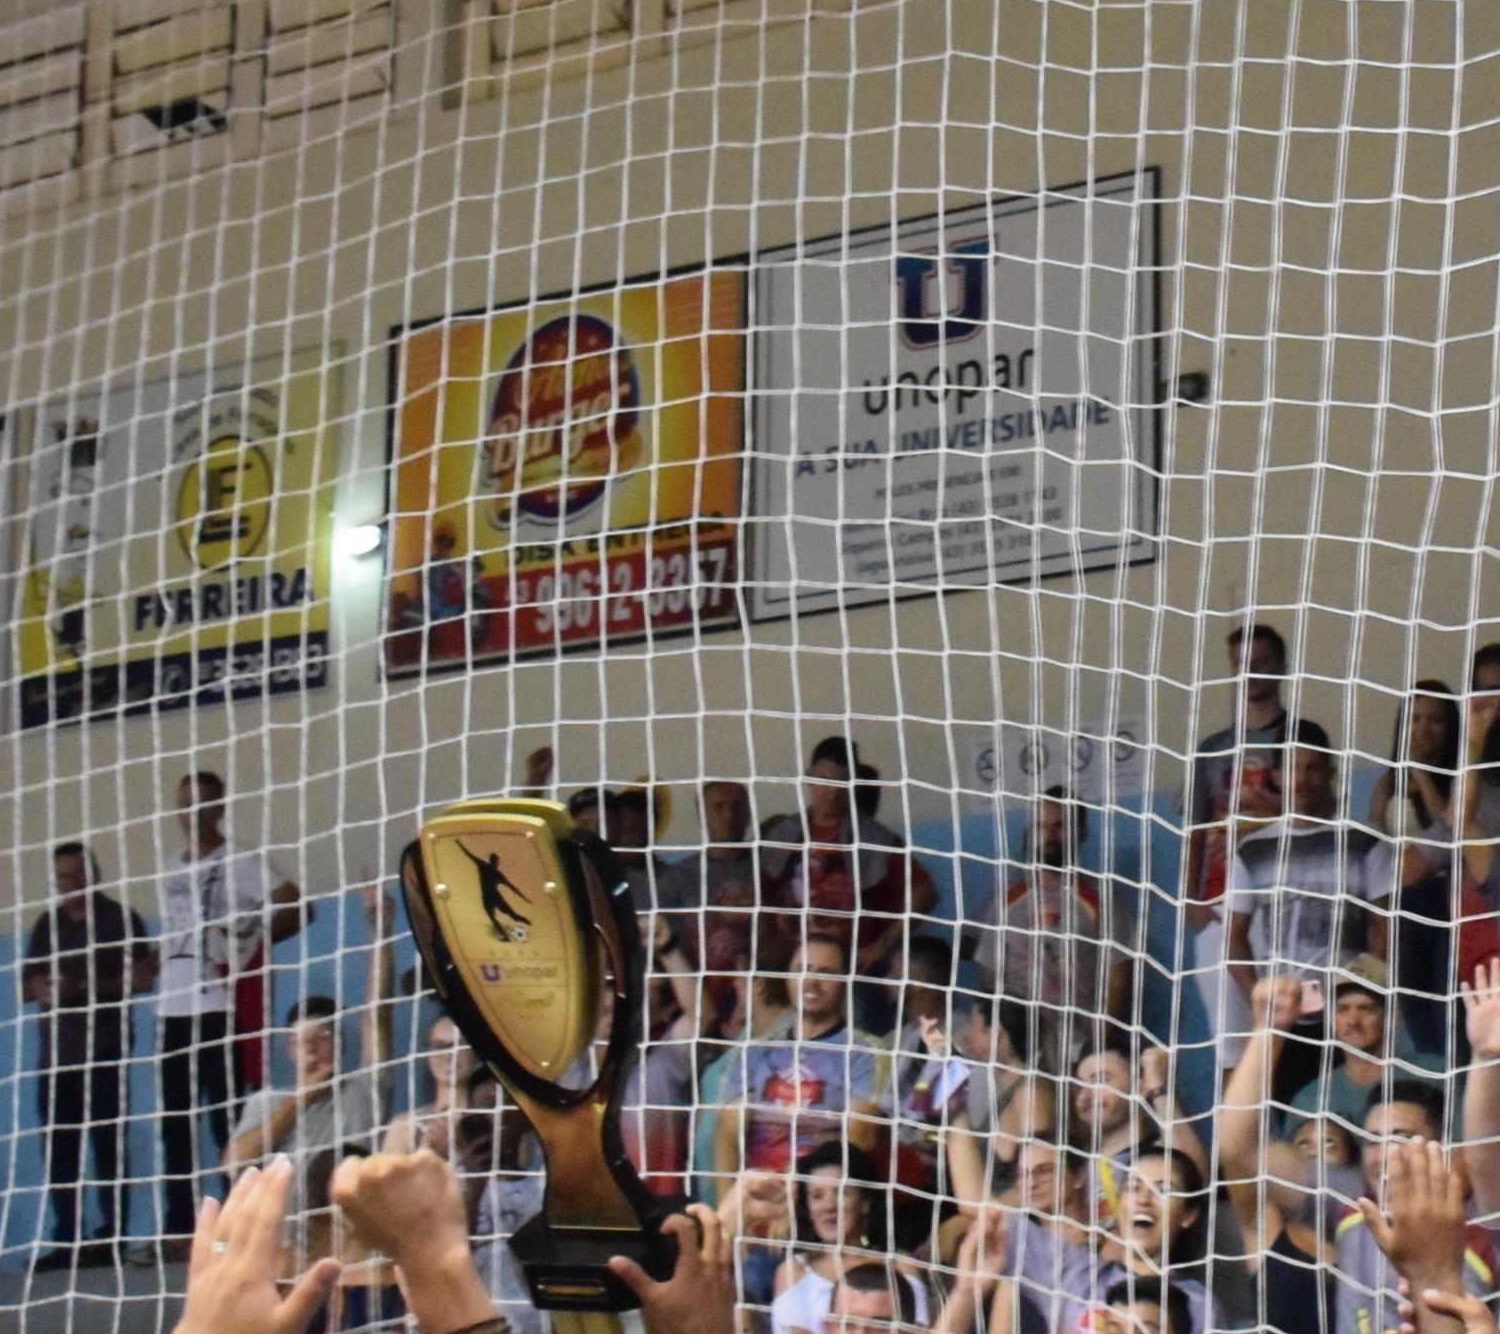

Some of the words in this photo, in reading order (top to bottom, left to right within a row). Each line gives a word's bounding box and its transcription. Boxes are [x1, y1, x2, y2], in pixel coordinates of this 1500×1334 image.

[891, 234, 998, 351] U
[863, 348, 1036, 415] unopar
[795, 451, 816, 479] A
[134, 567, 316, 631] FERREIRA
